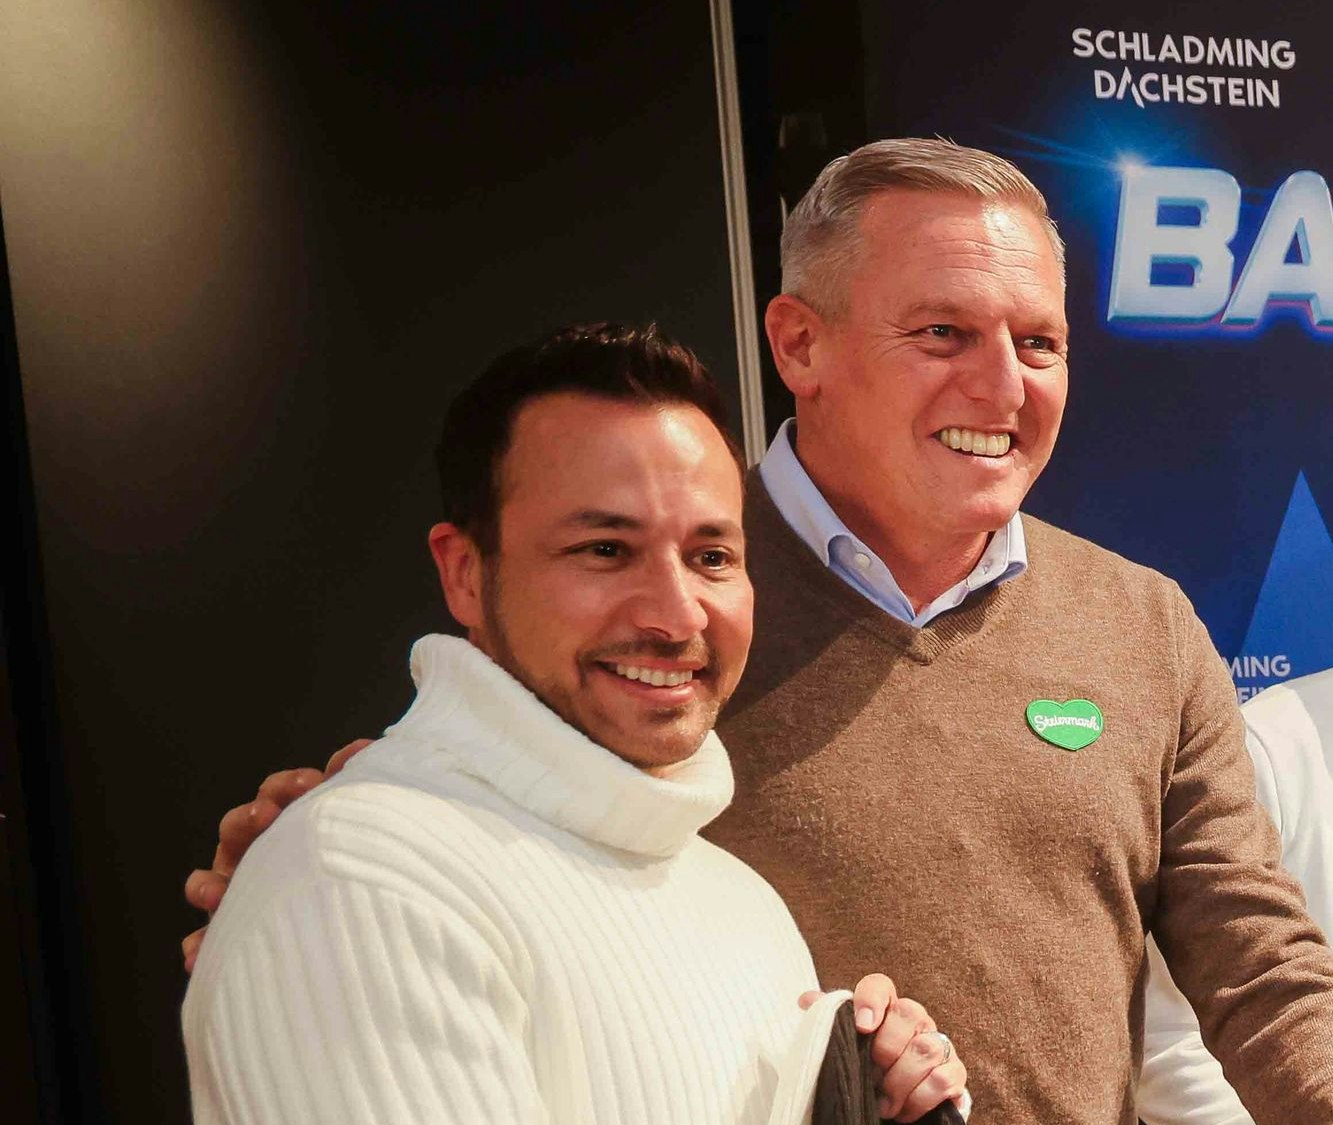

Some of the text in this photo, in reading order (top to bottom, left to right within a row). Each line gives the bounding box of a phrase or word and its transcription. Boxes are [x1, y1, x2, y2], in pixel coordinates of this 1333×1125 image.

[1071, 28, 1296, 70] SCHLADMING
[1094, 66, 1280, 108] DACHSTEIN
[1222, 655, 1291, 678] MING
[1034, 714, 1099, 733] Steiermark
